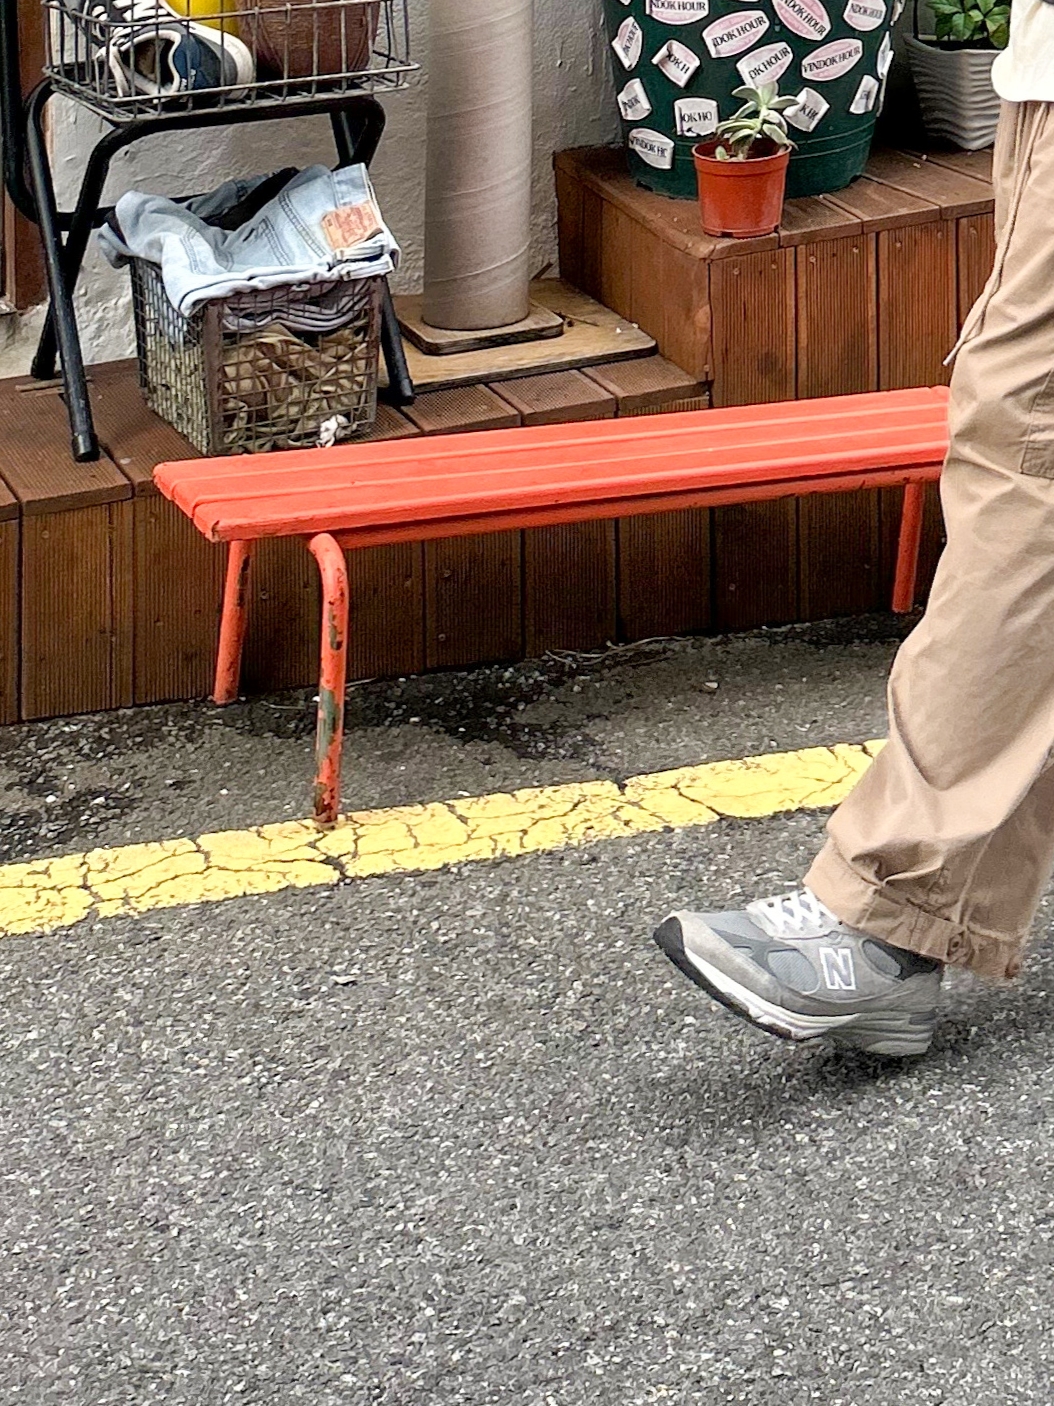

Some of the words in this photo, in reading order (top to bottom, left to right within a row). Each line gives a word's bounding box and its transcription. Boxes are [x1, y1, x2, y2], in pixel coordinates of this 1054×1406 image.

[677, 1, 707, 12] HOUR
[735, 15, 767, 36] HOUR
[803, 10, 827, 37] HOUR
[763, 46, 791, 71] HOUR
[819, 947, 857, 990] N
